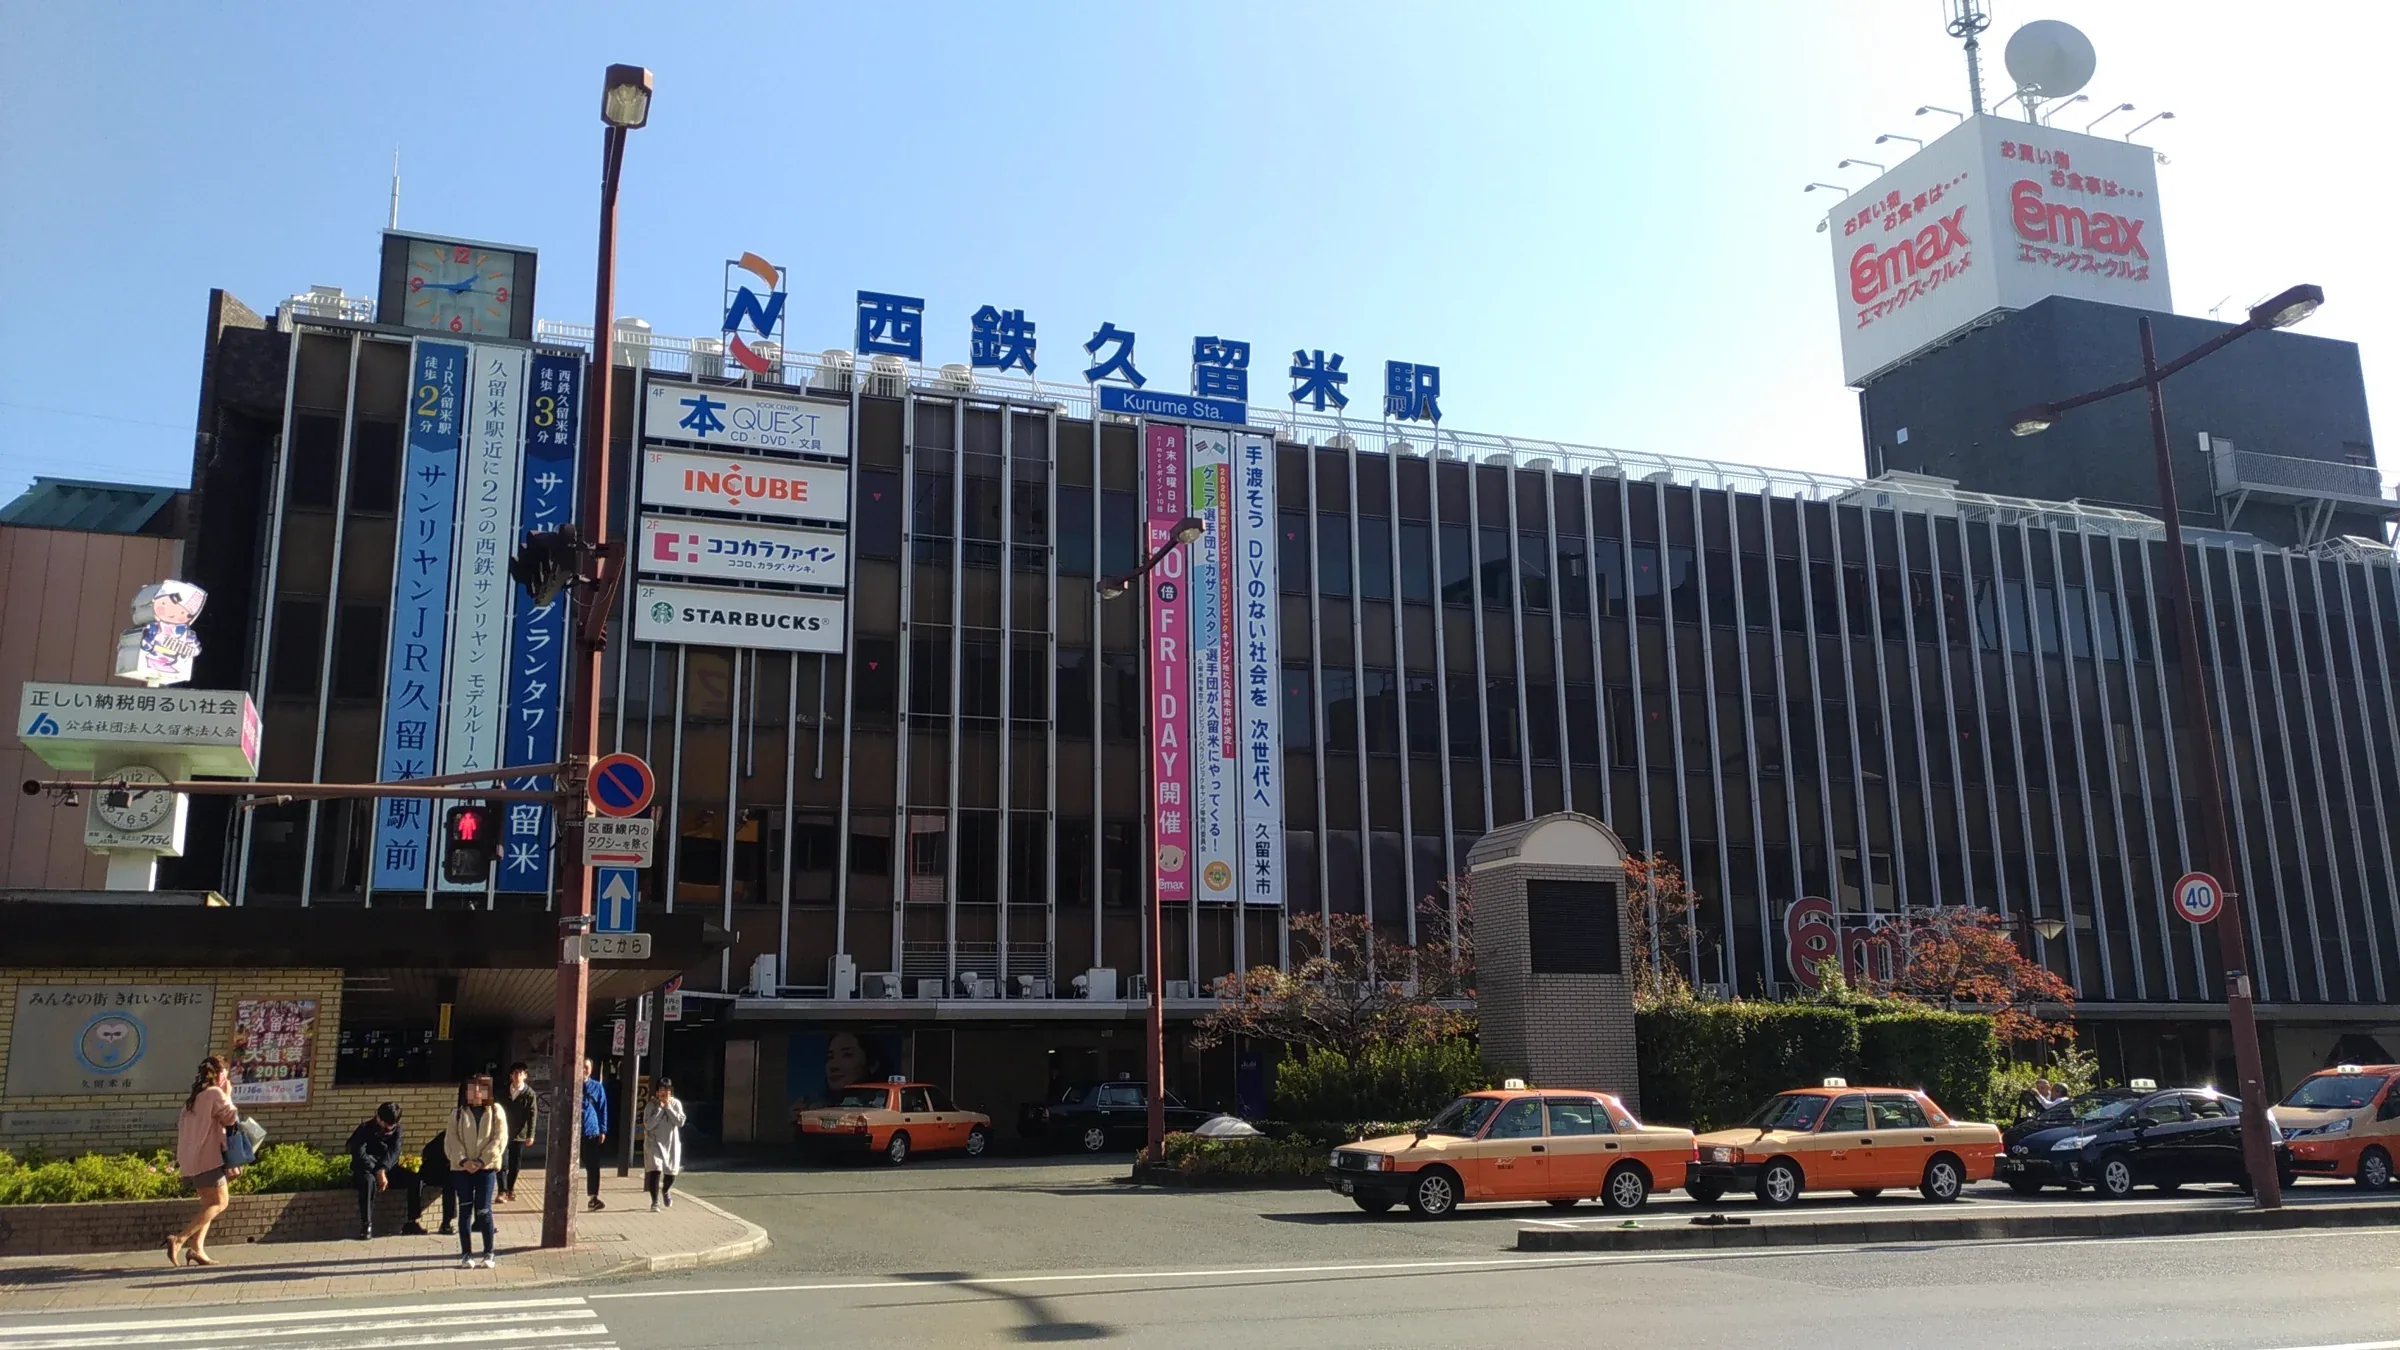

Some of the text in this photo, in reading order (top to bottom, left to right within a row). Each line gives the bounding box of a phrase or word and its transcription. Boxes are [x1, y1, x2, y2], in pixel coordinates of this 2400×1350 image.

[454, 247, 470, 263] 12
[496, 287, 508, 302] 3
[450, 316, 462, 332] 6
[856, 290, 1442, 422] 西鉄久留米駅
[652, 388, 665, 398] 4F
[756, 401, 800, 412] BOOK CENTER
[1123, 393, 1224, 420] Kurume Sta.
[679, 395, 726, 437] 本
[732, 407, 821, 437] QUEST
[649, 454, 662, 463] 3F
[684, 468, 809, 502] INCUBE
[1245, 445, 1264, 529] 手渡そう
[646, 520, 659, 530] 2F
[707, 538, 836, 563] ココカラファイン
[642, 588, 655, 598] 2F
[29, 689, 239, 717] 正しい納税明るい社会
[65, 719, 238, 738] 公益社団法人久留米法人会
[1251, 719, 1271, 808] 次世代へ
[155, 794, 163, 804] 3
[116, 812, 124, 822] 7
[140, 812, 148, 822] 5
[150, 805, 158, 814] 4
[127, 814, 135, 825] 6
[588, 823, 649, 836] 区画線内の
[587, 836, 649, 850] タクシーを除く
[1254, 822, 1271, 896] 久留米市
[2187, 887, 2212, 909] 40
[589, 938, 643, 954] ここから
[29, 992, 203, 1006] みんなの街 きれいな街に
[253, 1016, 301, 1033] 久留米
[247, 1032, 305, 1048] たまがる
[242, 1047, 304, 1064] 大道芸
[255, 1065, 288, 1078] 2019
[81, 1078, 133, 1089] 久留米市
